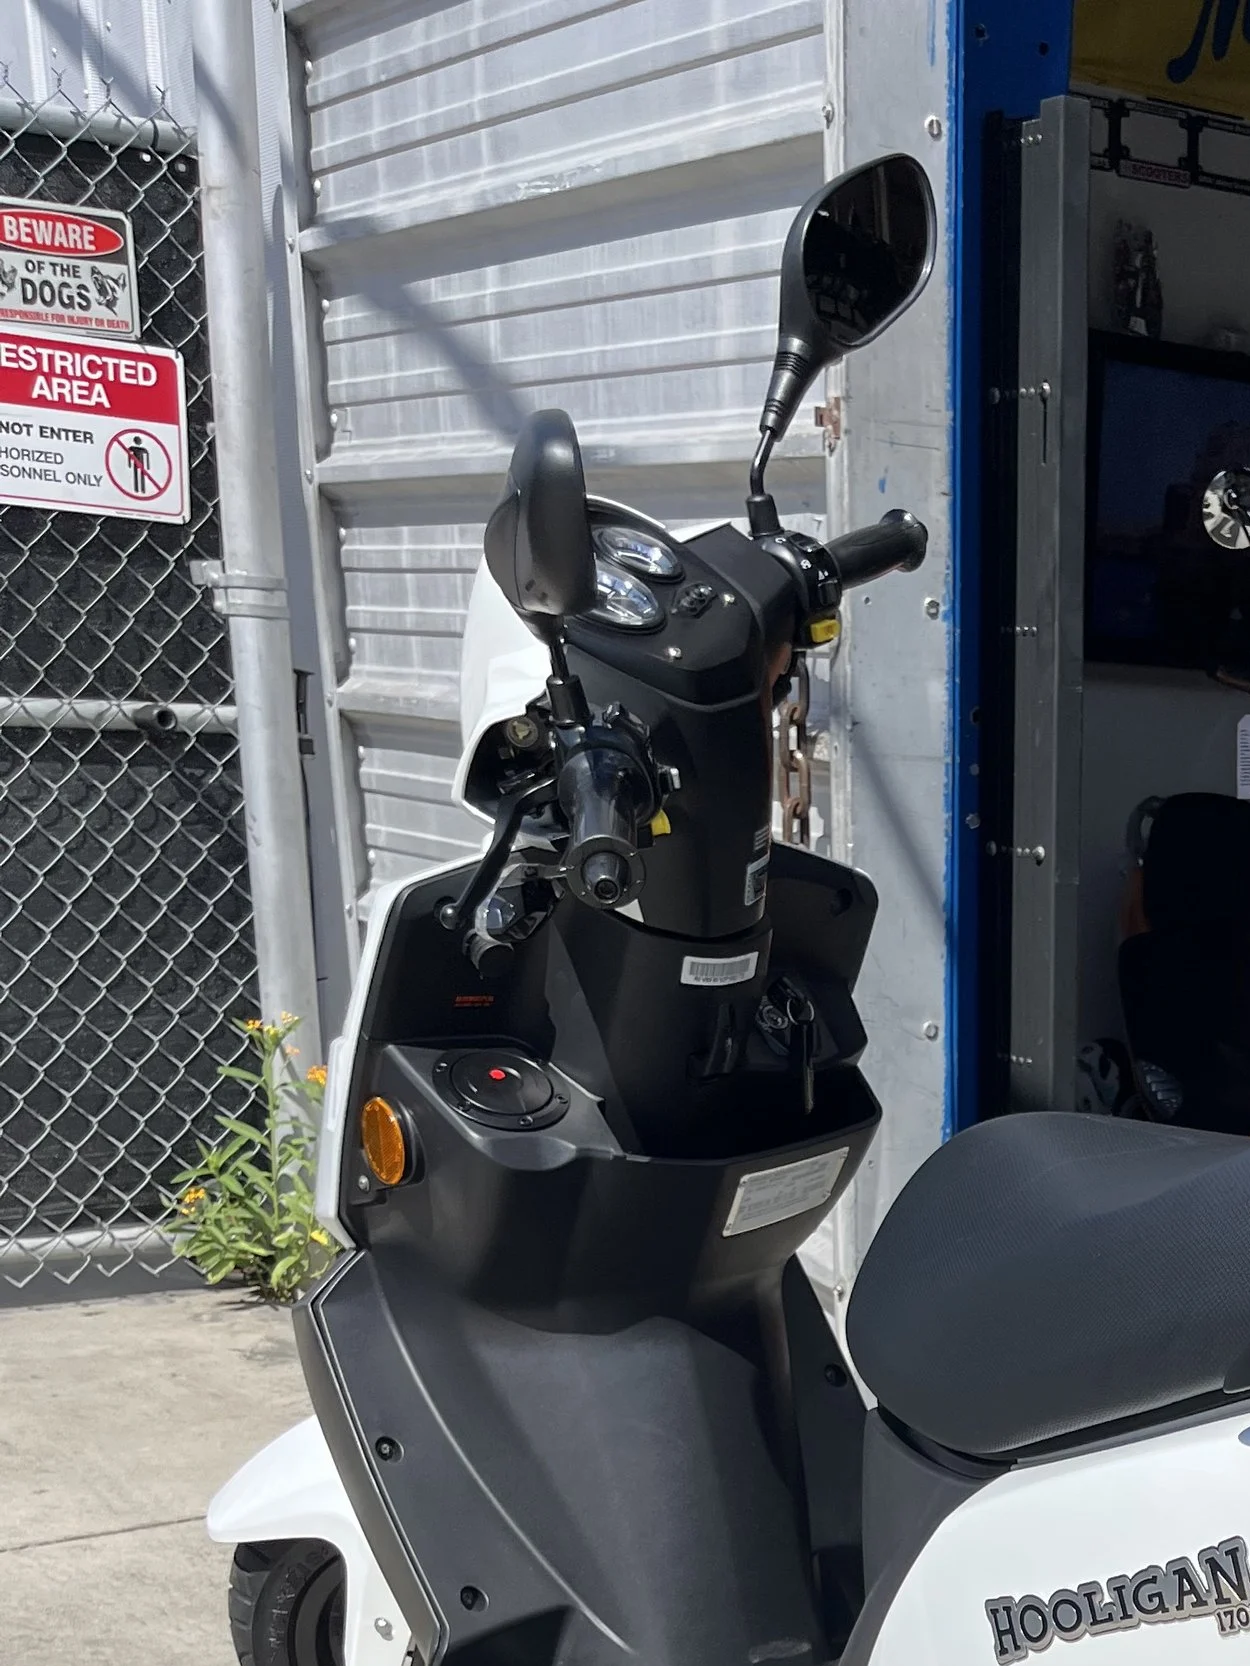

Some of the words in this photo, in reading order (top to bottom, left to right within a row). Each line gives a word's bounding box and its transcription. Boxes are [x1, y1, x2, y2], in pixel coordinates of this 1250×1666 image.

[3, 214, 96, 251] BEWARE
[25, 259, 45, 275] OF
[49, 262, 82, 279] THE
[21, 277, 92, 312] DOGS
[51, 313, 66, 324] FOR
[67, 315, 93, 327] INJURY
[95, 318, 105, 328] OR
[106, 319, 130, 330] DEATH
[0, 343, 157, 387] ESTRICTED
[31, 375, 111, 408] AREA
[0, 421, 33, 437] NOT
[39, 425, 94, 444] ENTER
[0, 446, 64, 465] HORIZED
[0, 464, 62, 483] SONNEL
[65, 471, 103, 487] ONLY
[988, 1544, 1250, 1658] HOOLIGAN
